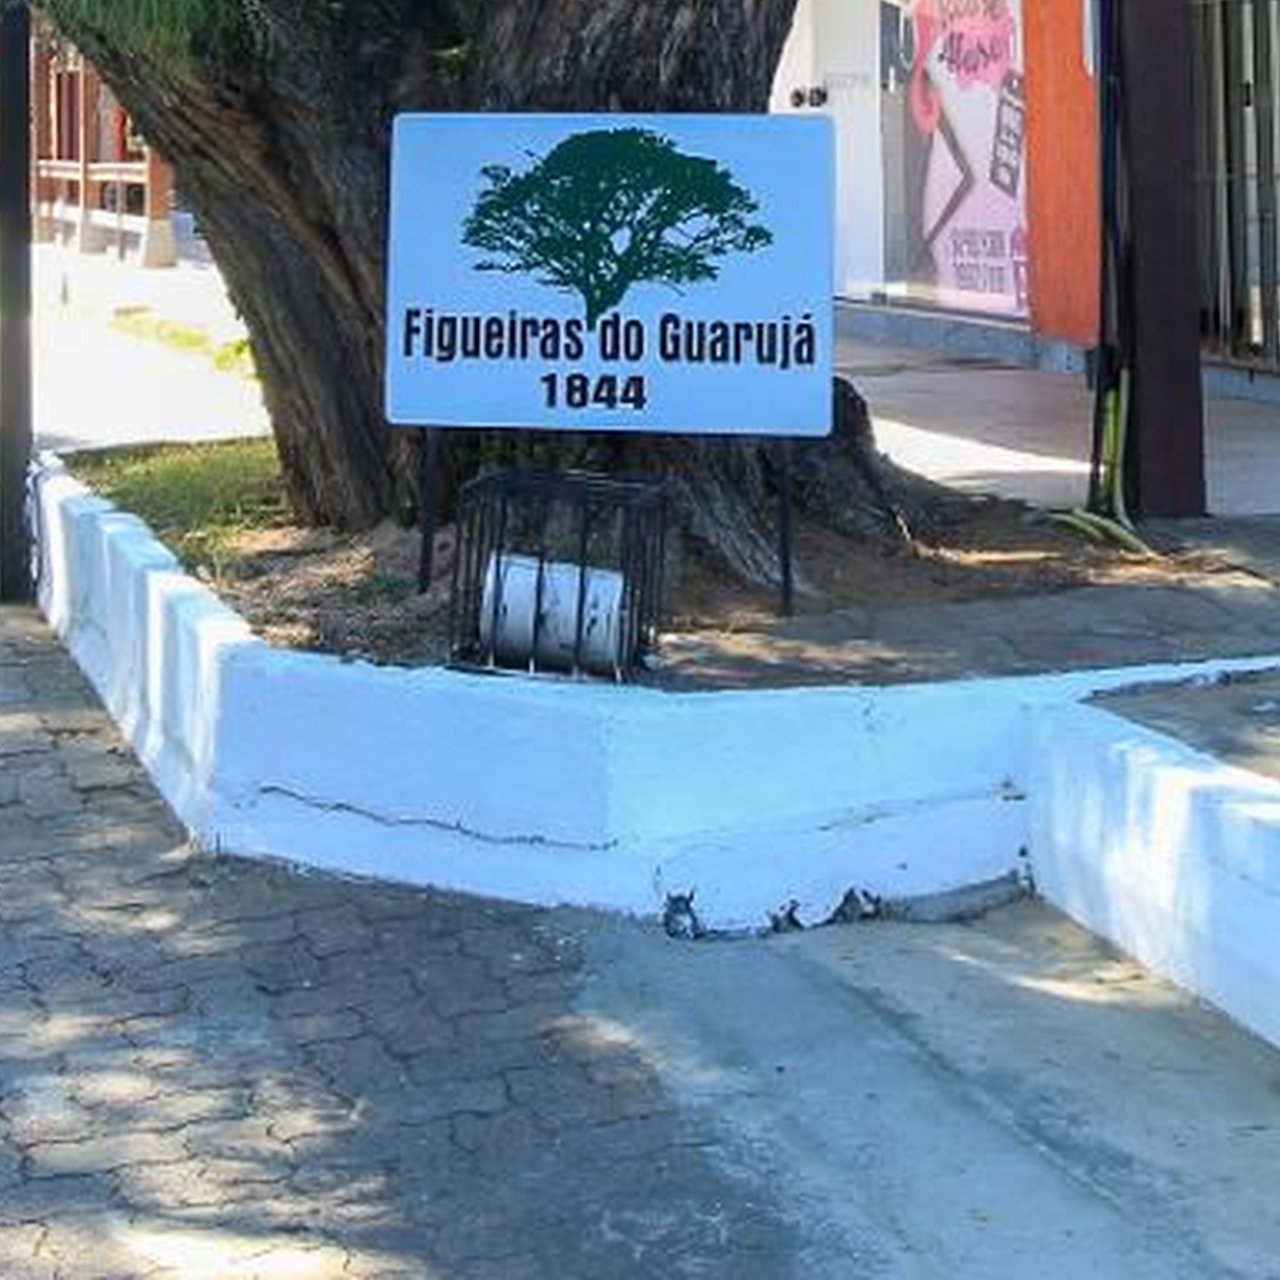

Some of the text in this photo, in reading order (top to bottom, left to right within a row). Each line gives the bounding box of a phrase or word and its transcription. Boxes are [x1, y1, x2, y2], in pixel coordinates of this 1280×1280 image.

[402, 310, 816, 369] Figueiras do Guarujá
[540, 374, 647, 409] 1844
